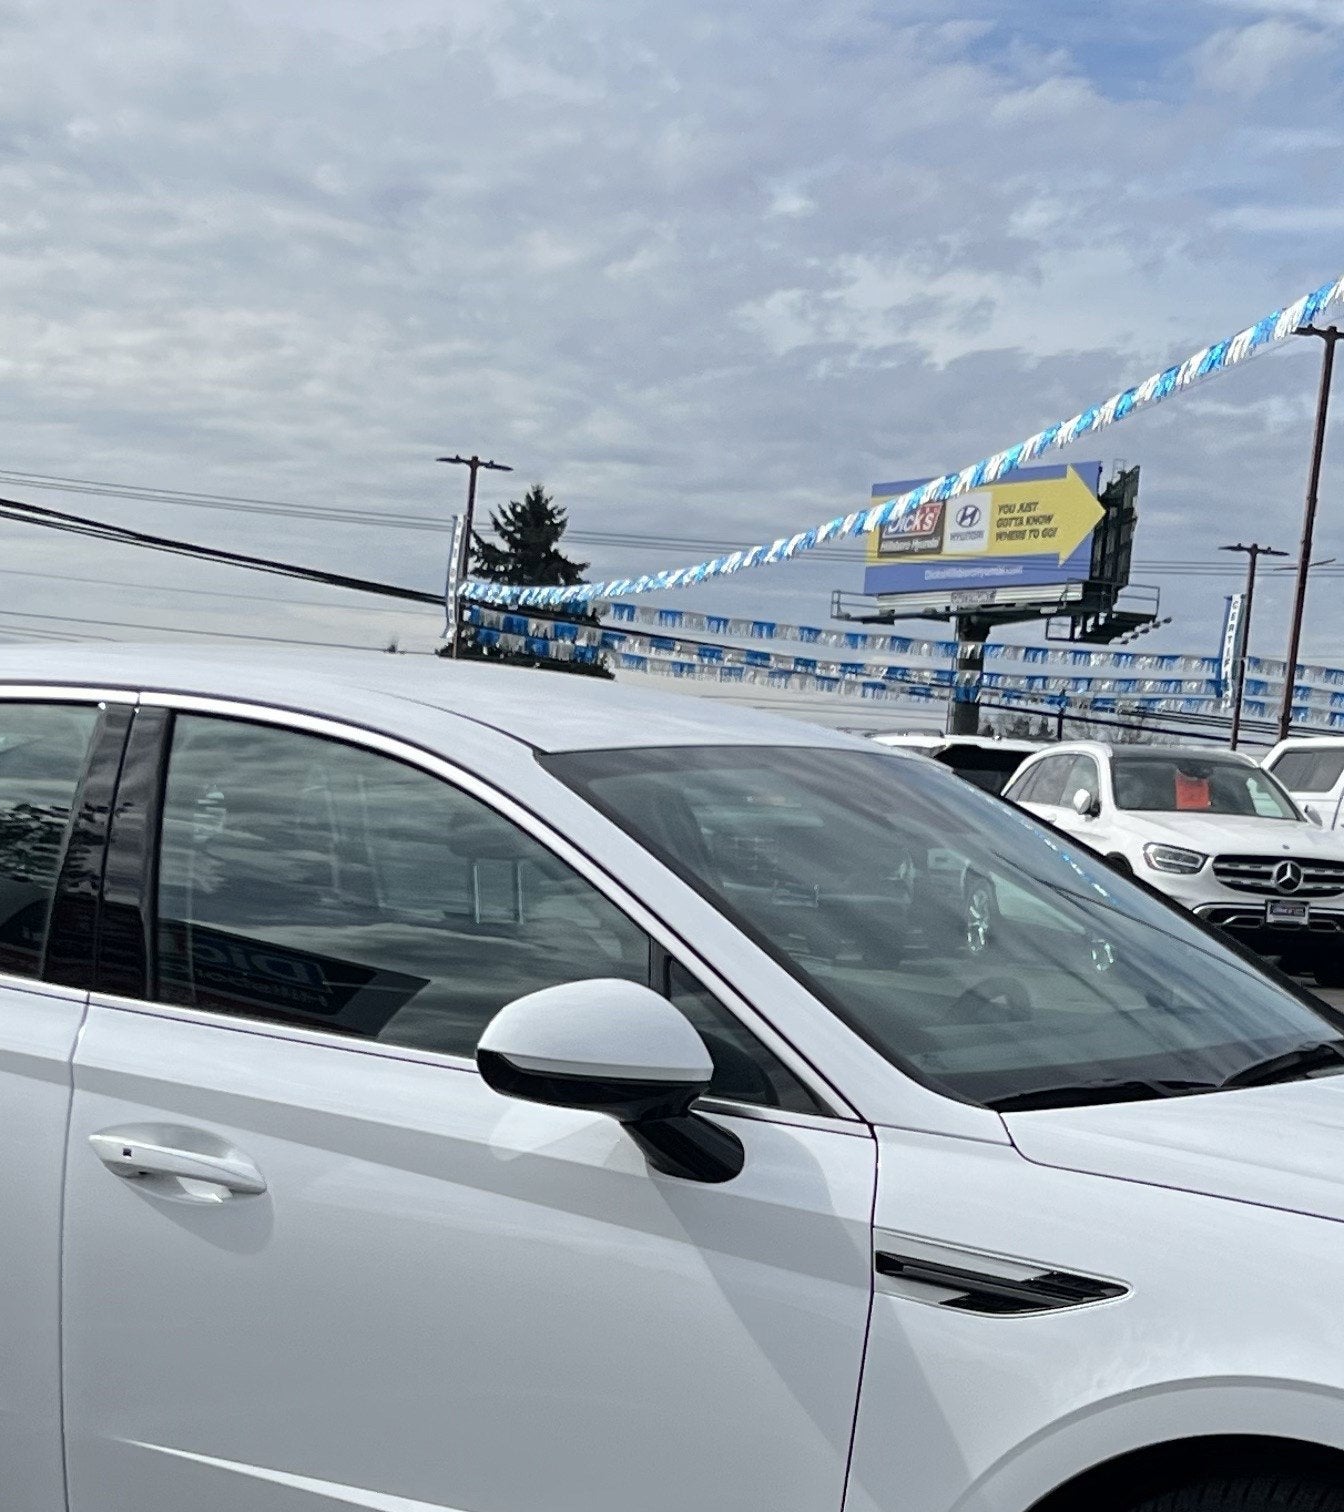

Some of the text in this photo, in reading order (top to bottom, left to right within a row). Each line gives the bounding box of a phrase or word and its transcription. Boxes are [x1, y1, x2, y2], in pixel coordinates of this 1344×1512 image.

[998, 503, 1016, 515] YOU
[997, 513, 1054, 528] GOTTA KNOW
[996, 529, 1027, 541] WHERE
[1028, 529, 1040, 540] TO
